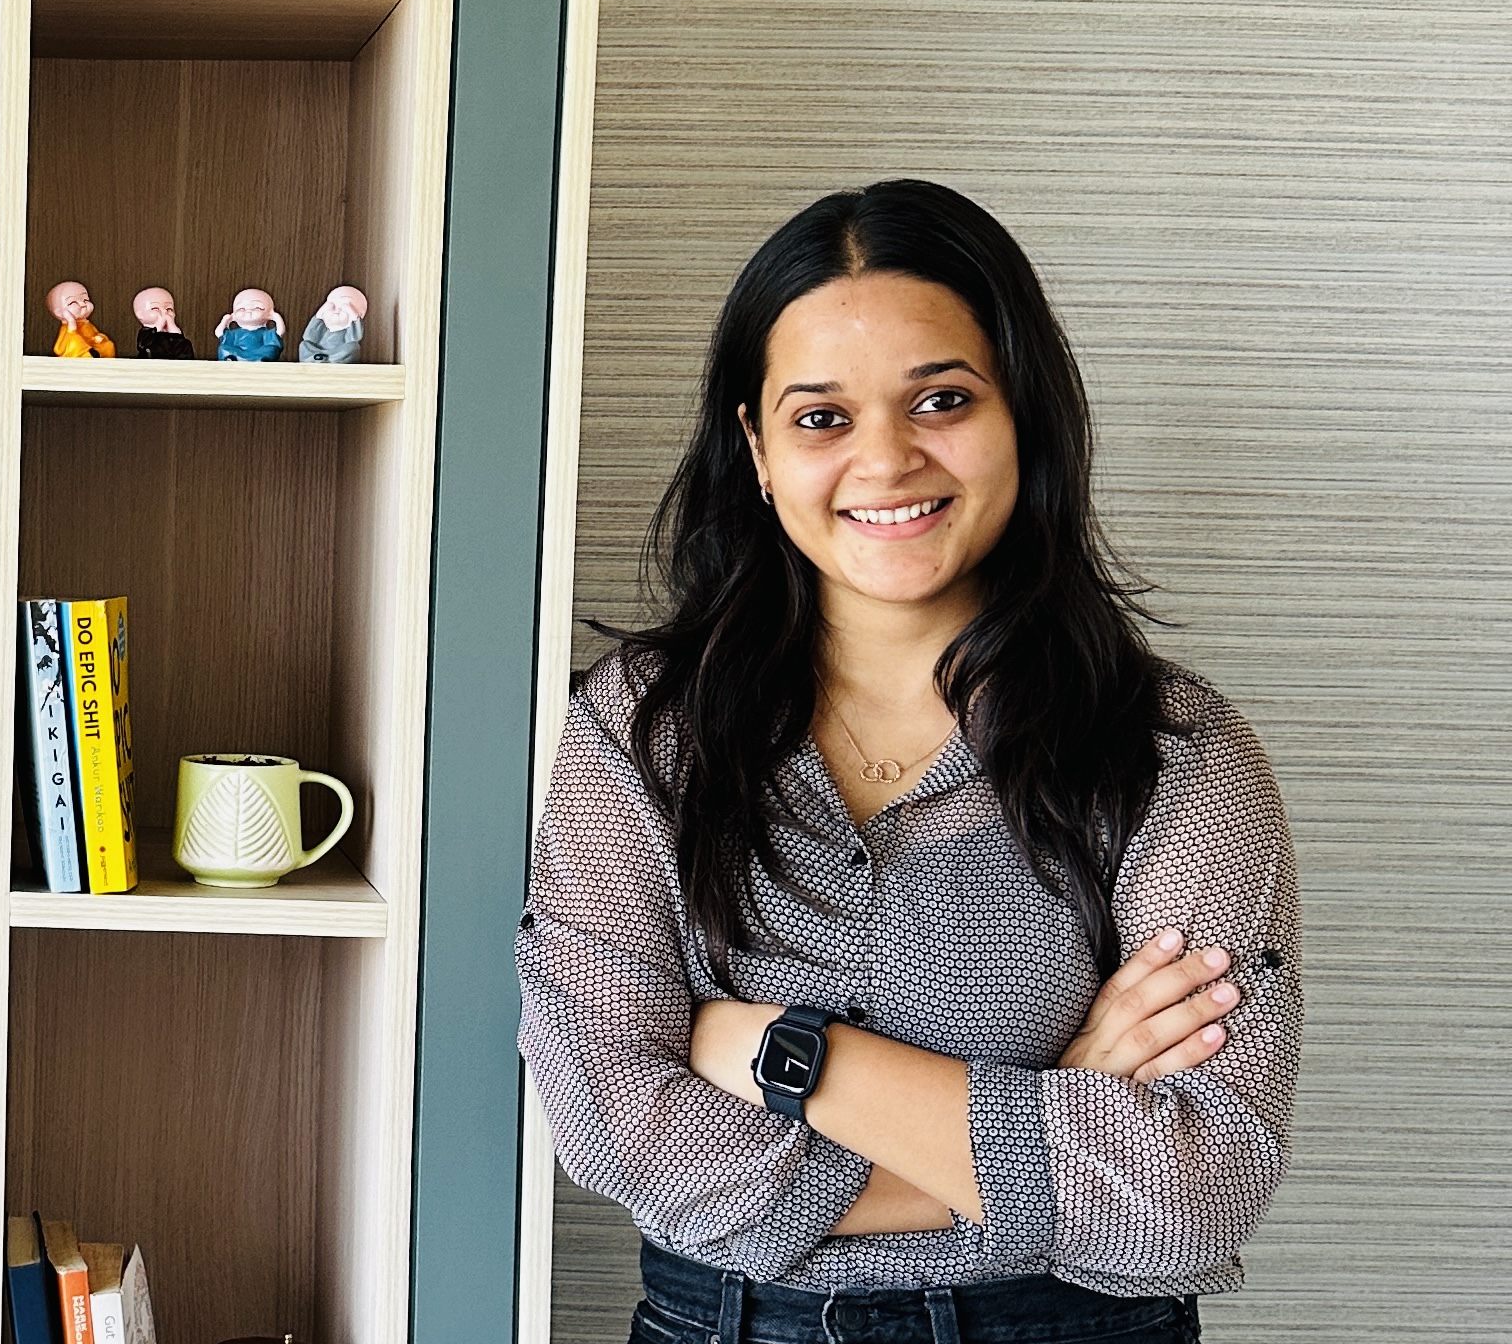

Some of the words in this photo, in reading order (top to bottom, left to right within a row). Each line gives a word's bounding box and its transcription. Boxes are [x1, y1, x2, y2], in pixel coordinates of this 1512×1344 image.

[77, 617, 93, 645] DO
[79, 651, 97, 693] EPIC
[83, 699, 101, 739] SHIT
[48, 704, 67, 831] IKIGAI
[91, 746, 101, 782] Ankur
[104, 1315, 116, 1339] Gut
